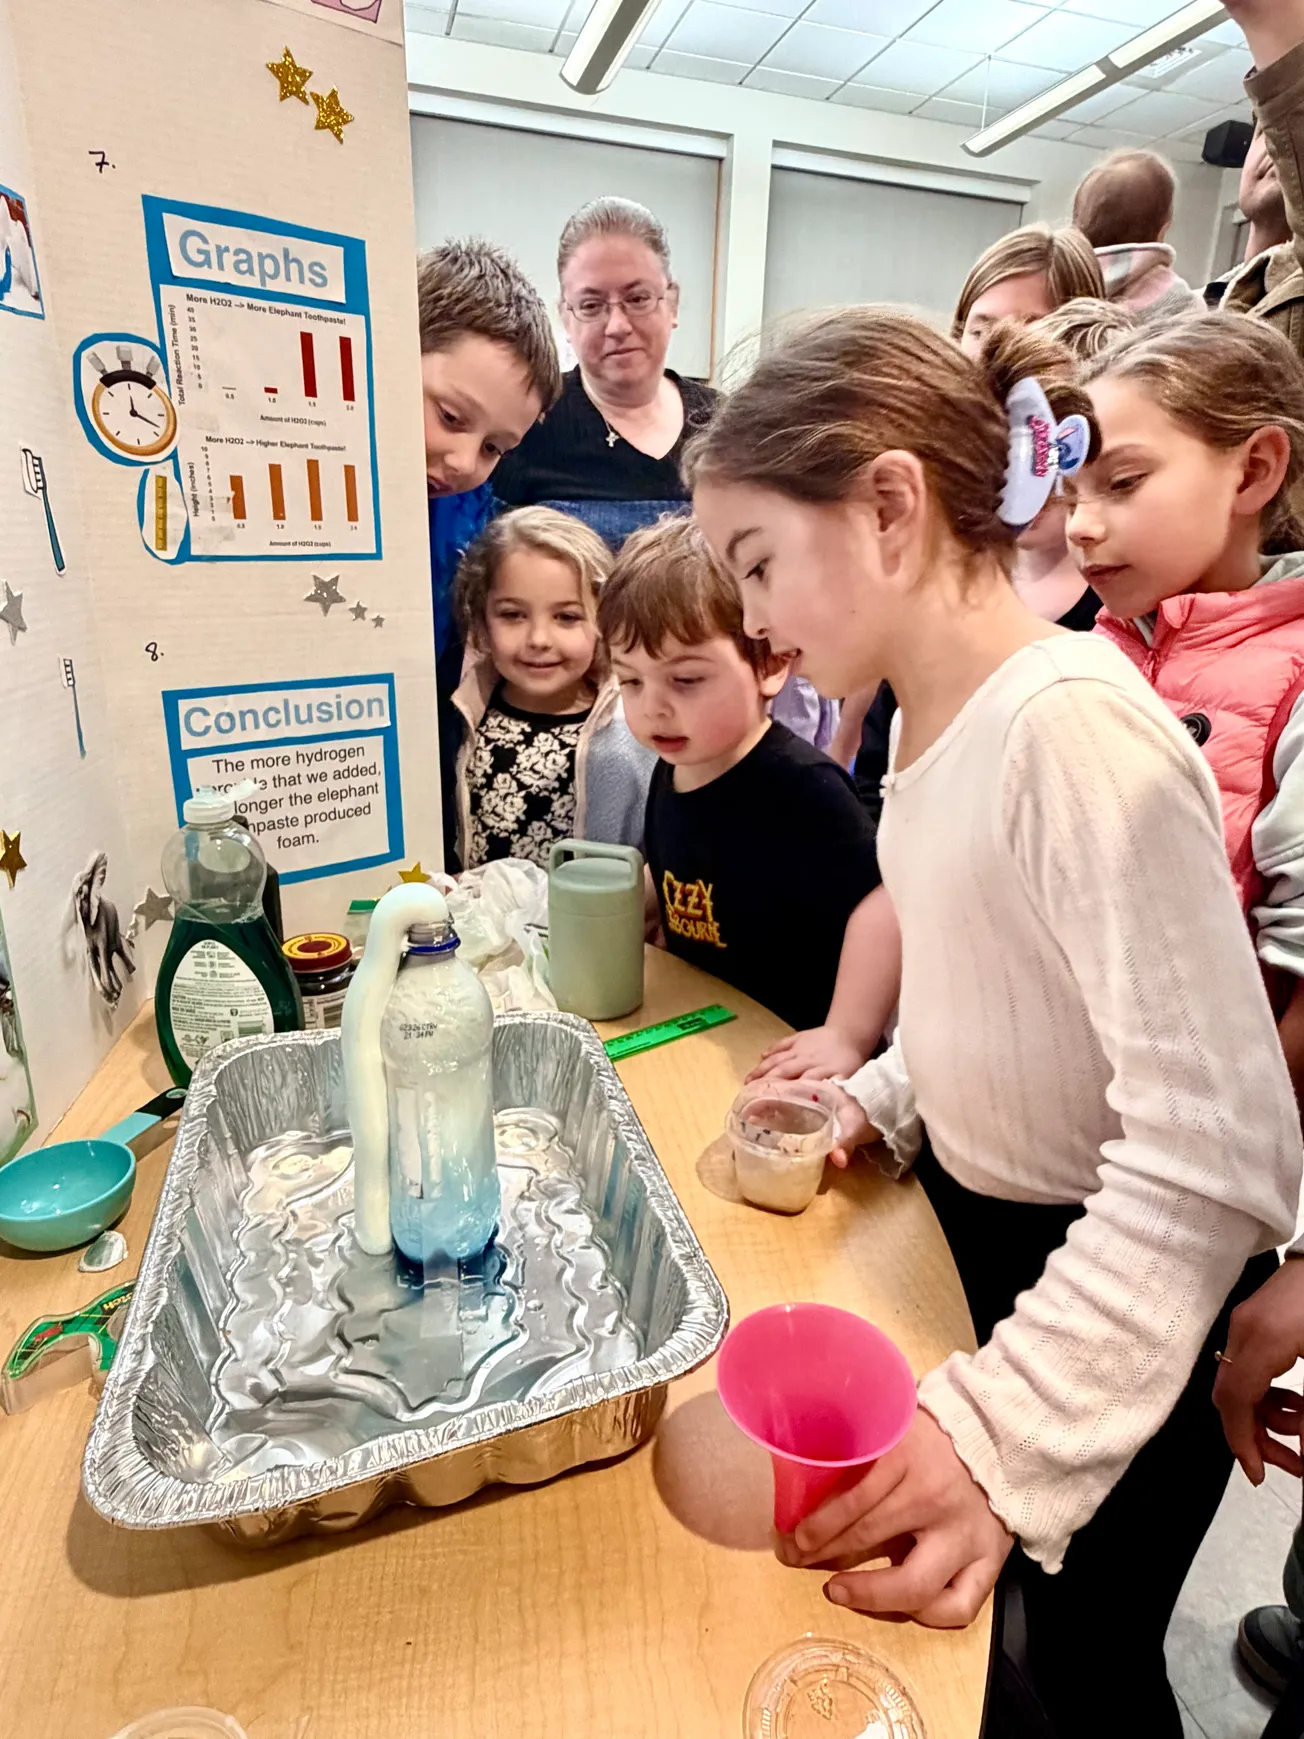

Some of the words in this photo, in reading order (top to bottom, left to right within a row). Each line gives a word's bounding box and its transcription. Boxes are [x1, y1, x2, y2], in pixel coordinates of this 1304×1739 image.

[88, 150, 116, 174] 7.
[178, 229, 329, 288] Graphs
[168, 304, 178, 326] (min)
[186, 293, 208, 304] More
[210, 297, 233, 308] H2O2
[247, 302, 267, 313] More
[268, 305, 302, 319] Elephant
[304, 311, 346, 325] Toothpaste!
[174, 349, 183, 385] Reaction
[260, 415, 283, 423] Amount
[205, 435, 224, 443] More
[225, 437, 244, 445] H2O2
[256, 438, 278, 448] Higher
[280, 440, 309, 449] Elephant
[187, 461, 198, 492] (inches)
[191, 493, 200, 517] Height
[145, 641, 164, 661] 8.
[183, 694, 385, 737] Conclusion
[212, 758, 245, 774] The
[250, 753, 291, 770] more
[295, 746, 365, 767] hydrogen
[272, 772, 302, 789] that
[306, 771, 328, 784] we
[332, 762, 381, 781] added,
[233, 796, 284, 814] longer
[289, 792, 312, 807] the
[317, 782, 379, 803] elephant
[304, 802, 371, 827] produced
[277, 833, 320, 849] foam.
